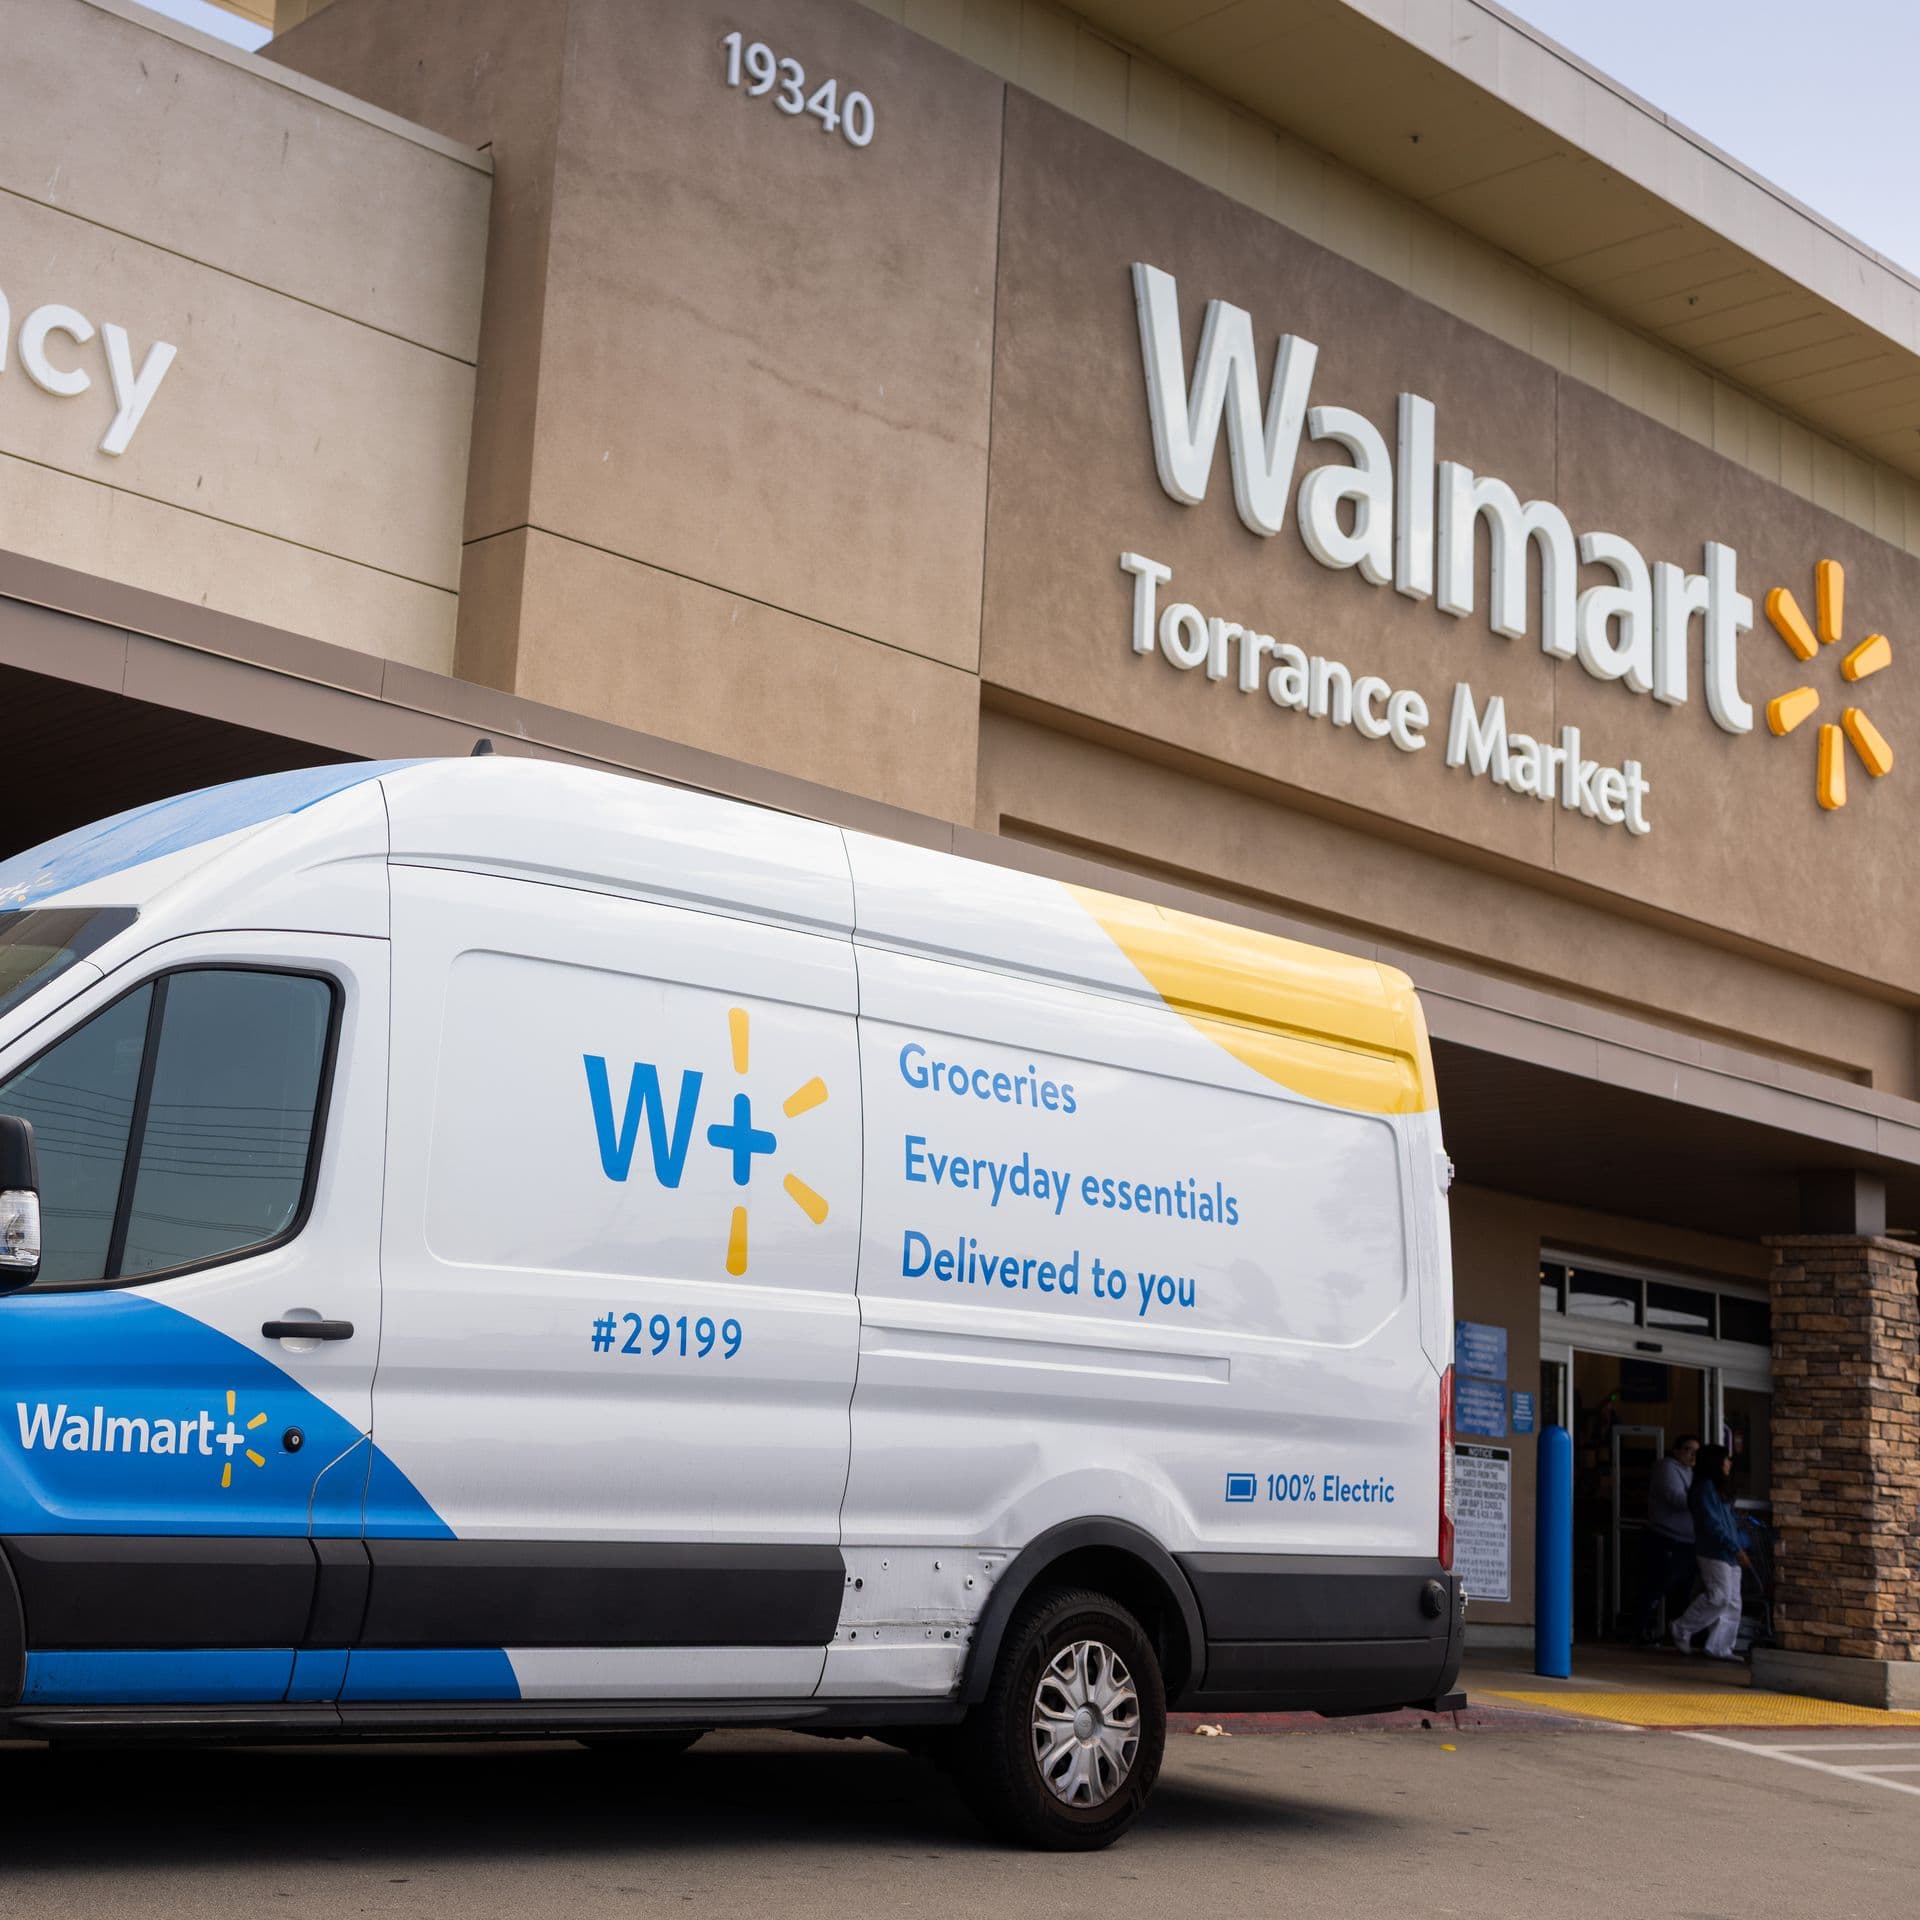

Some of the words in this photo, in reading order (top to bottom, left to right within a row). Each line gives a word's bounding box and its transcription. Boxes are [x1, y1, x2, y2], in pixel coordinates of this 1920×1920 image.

[723, 31, 874, 147] 19340
[0, 287, 177, 456] cy
[1131, 262, 1753, 734] Walmart
[1120, 551, 1430, 752] Torrance
[1446, 682, 1650, 835] Market
[899, 1042, 1077, 1114] Groceries
[904, 1134, 1070, 1216] Everyday
[1081, 1176, 1239, 1226] essentials
[902, 1230, 1079, 1295] Delivered
[1092, 1258, 1127, 1299] to
[1138, 1272, 1196, 1317] you
[591, 1311, 743, 1361] #29199
[1267, 1473, 1317, 1502] 100%
[1323, 1474, 1396, 1503] Electric
[1468, 1447, 1493, 1458] NOTICE
